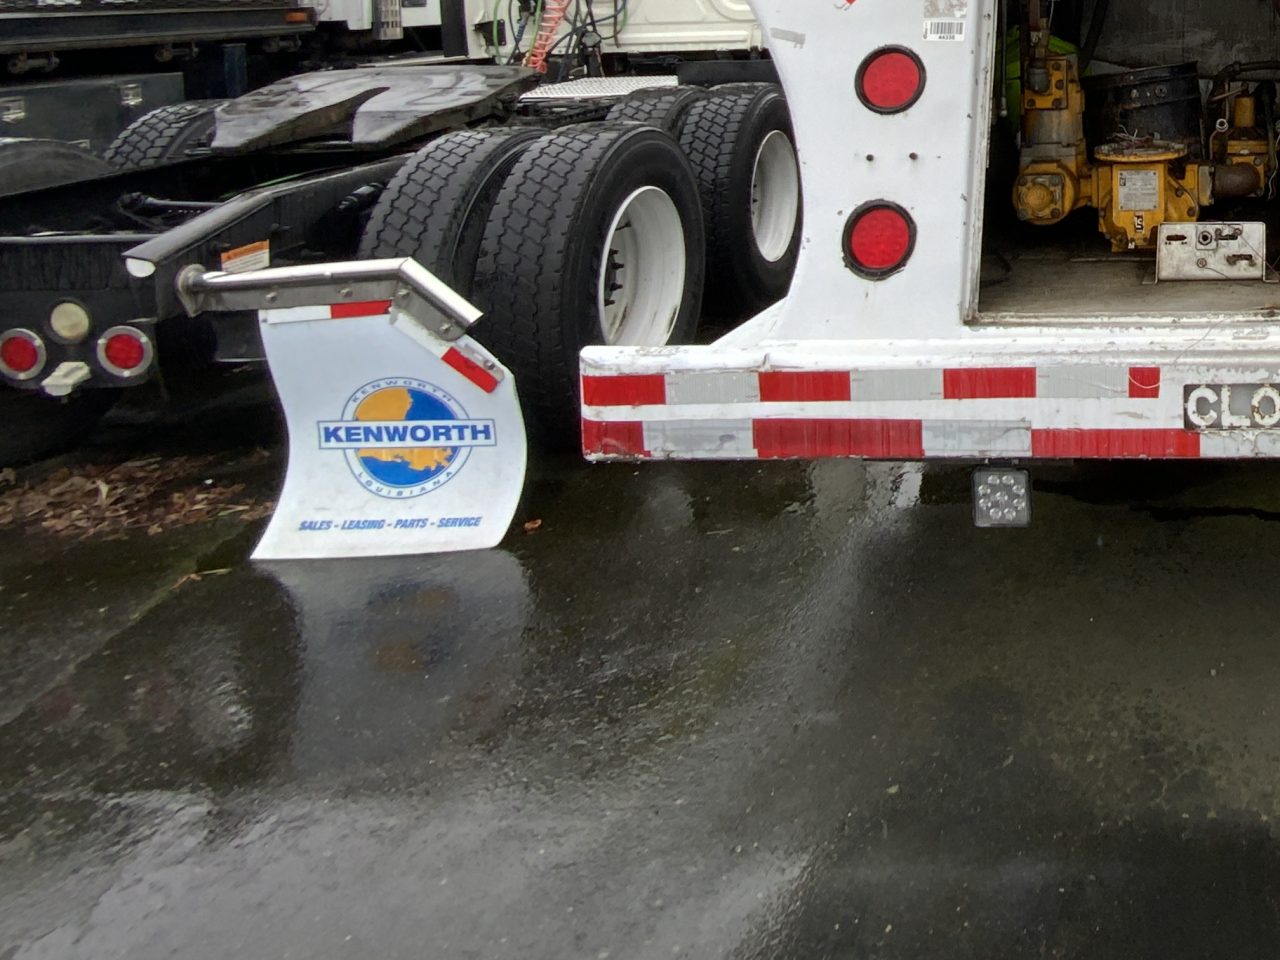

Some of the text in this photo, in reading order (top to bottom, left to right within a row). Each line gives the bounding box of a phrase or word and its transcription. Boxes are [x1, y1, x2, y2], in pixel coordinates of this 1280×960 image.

[351, 379, 453, 404] KENWORTH
[323, 424, 492, 443] KENWORTH
[356, 471, 453, 497] LOUISIANA
[299, 520, 332, 531] SALES
[341, 519, 385, 530] LEASING
[394, 518, 429, 529] PARTS
[437, 516, 483, 528] SERVICE
